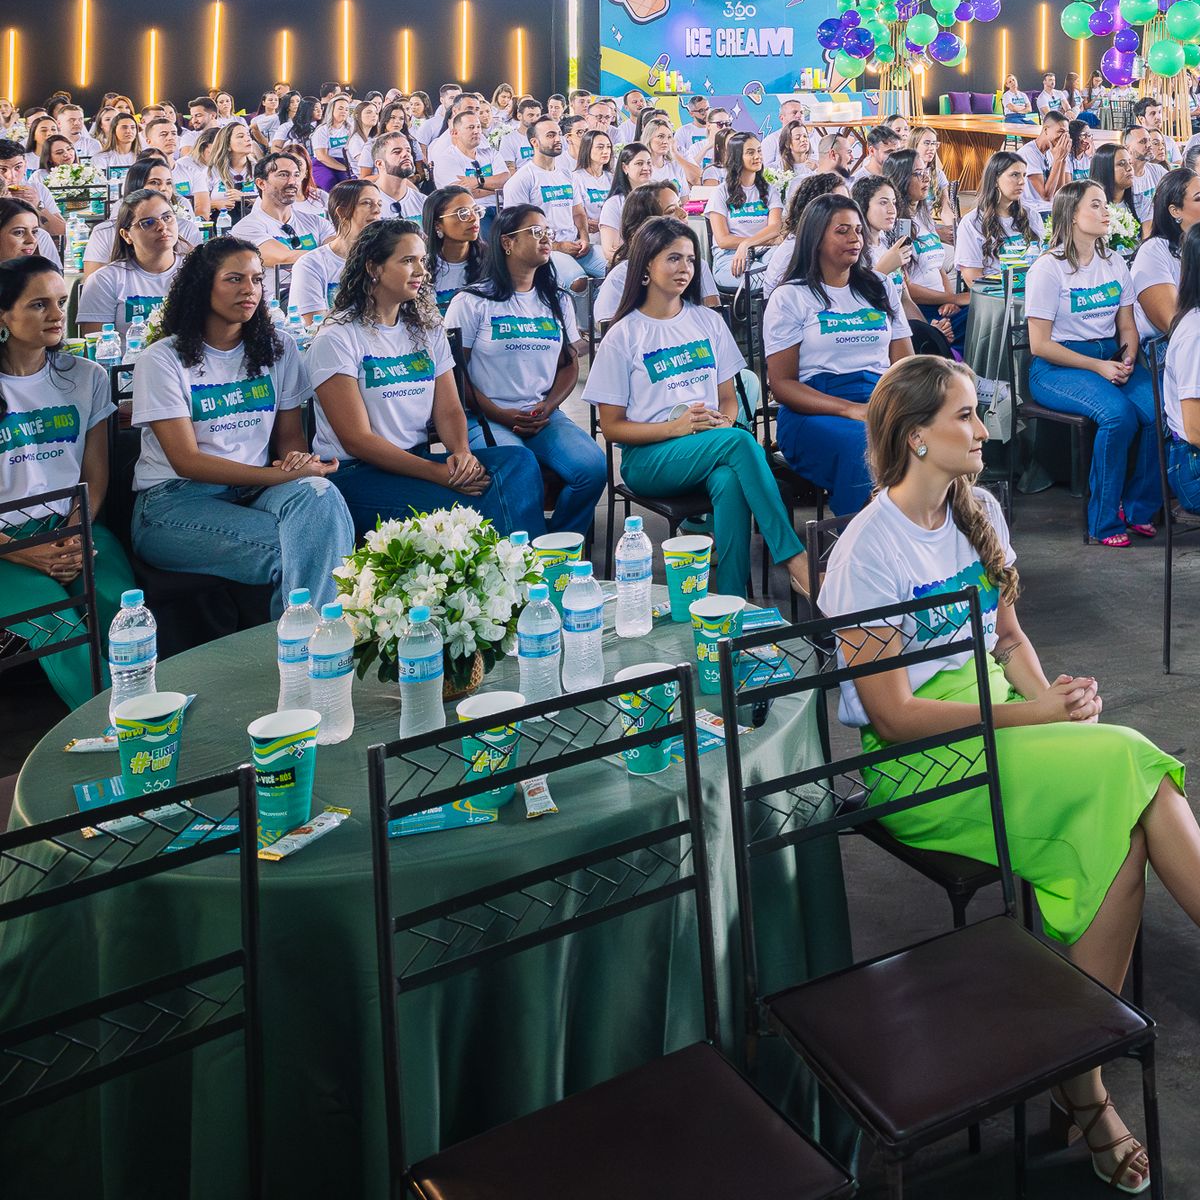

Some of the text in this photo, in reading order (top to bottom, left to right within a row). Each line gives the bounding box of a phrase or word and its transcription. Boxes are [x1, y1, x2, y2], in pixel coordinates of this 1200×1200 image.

[723, 1, 756, 20] 360
[686, 27, 793, 57] ICE CREAM
[499, 323, 511, 333] EU
[505, 343, 550, 351] SOMOS COOP
[653, 359, 667, 374] EU
[690, 373, 709, 384] COOP
[382, 387, 425, 399] SOMOS COOP
[201, 397, 216, 412] EU
[210, 418, 261, 432] SOMOS COOP
[36, 449, 64, 460] COOP
